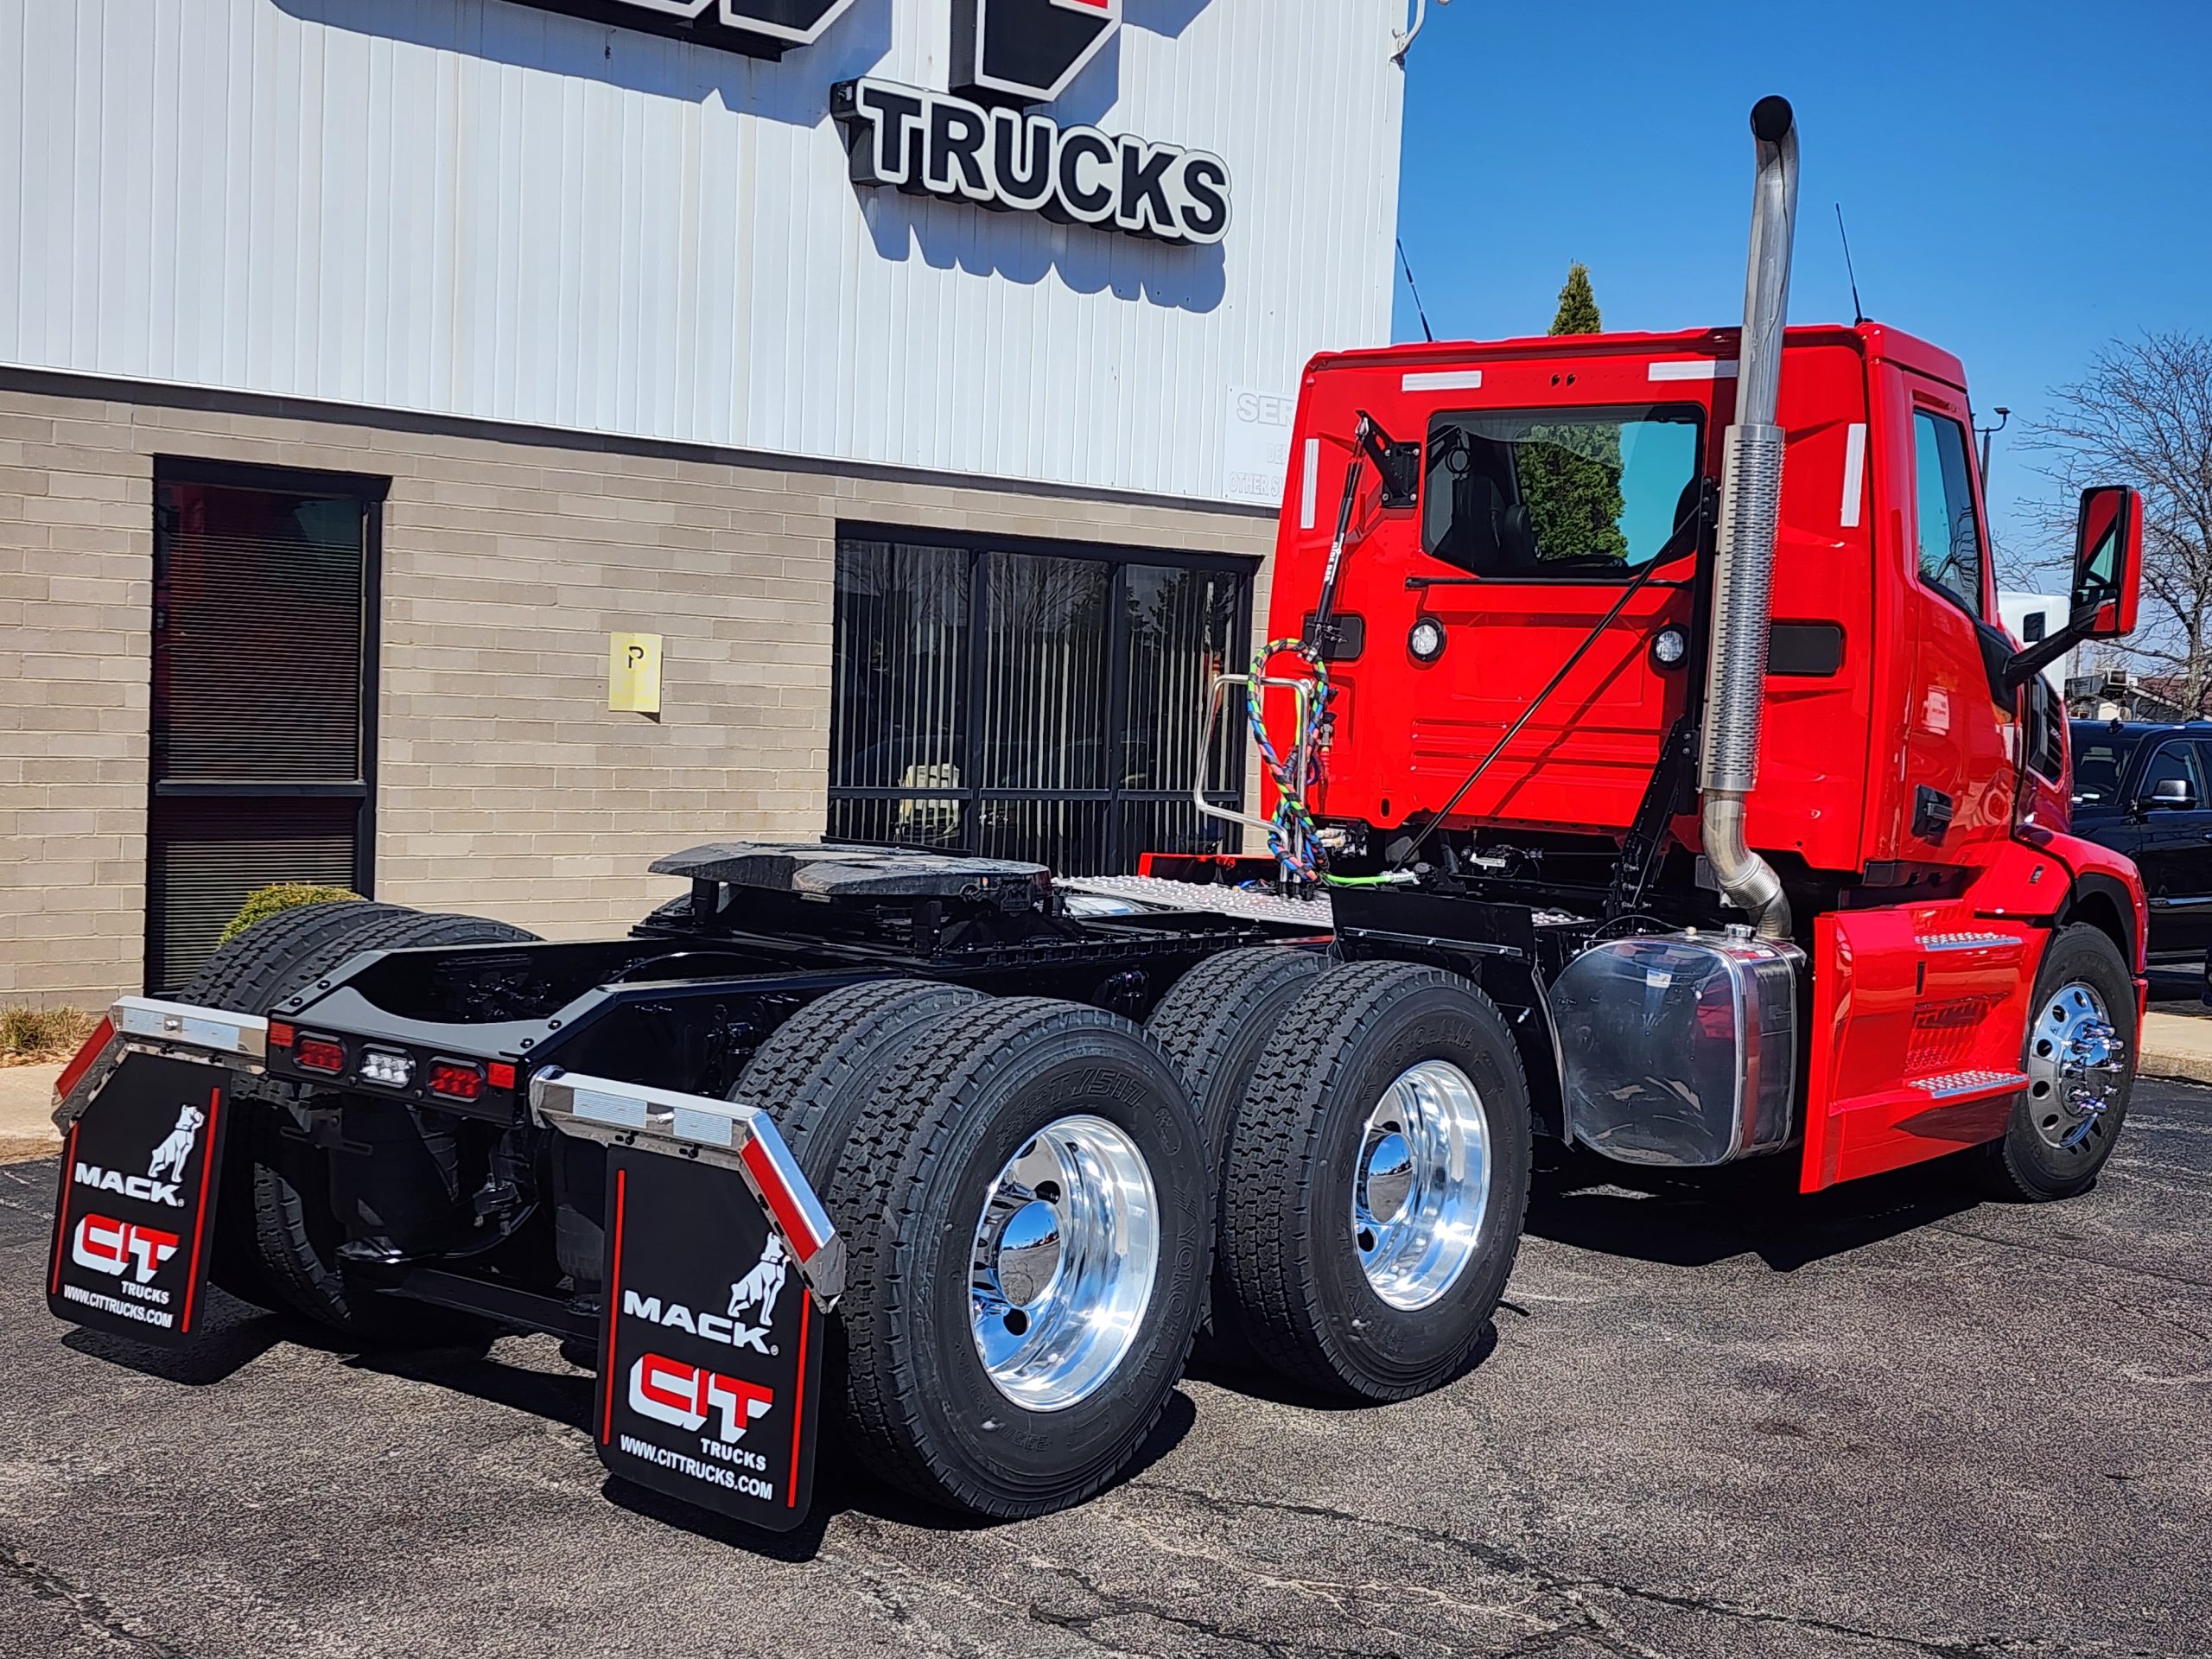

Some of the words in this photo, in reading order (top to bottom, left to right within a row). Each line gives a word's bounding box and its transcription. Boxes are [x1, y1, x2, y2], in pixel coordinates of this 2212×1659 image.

[859, 81, 1231, 242] TRUCKS
[1229, 471, 1269, 497] OTHER
[628, 645, 645, 669] P
[72, 1213, 181, 1283] CIT
[63, 1284, 174, 1329] WWW.CITTRUCKS.COM
[121, 1281, 170, 1305] TRUCKS
[628, 1351, 774, 1444] CIT
[620, 1434, 774, 1501] WWW.CITTRUCKS.COM
[700, 1438, 767, 1471] TRUCKS
